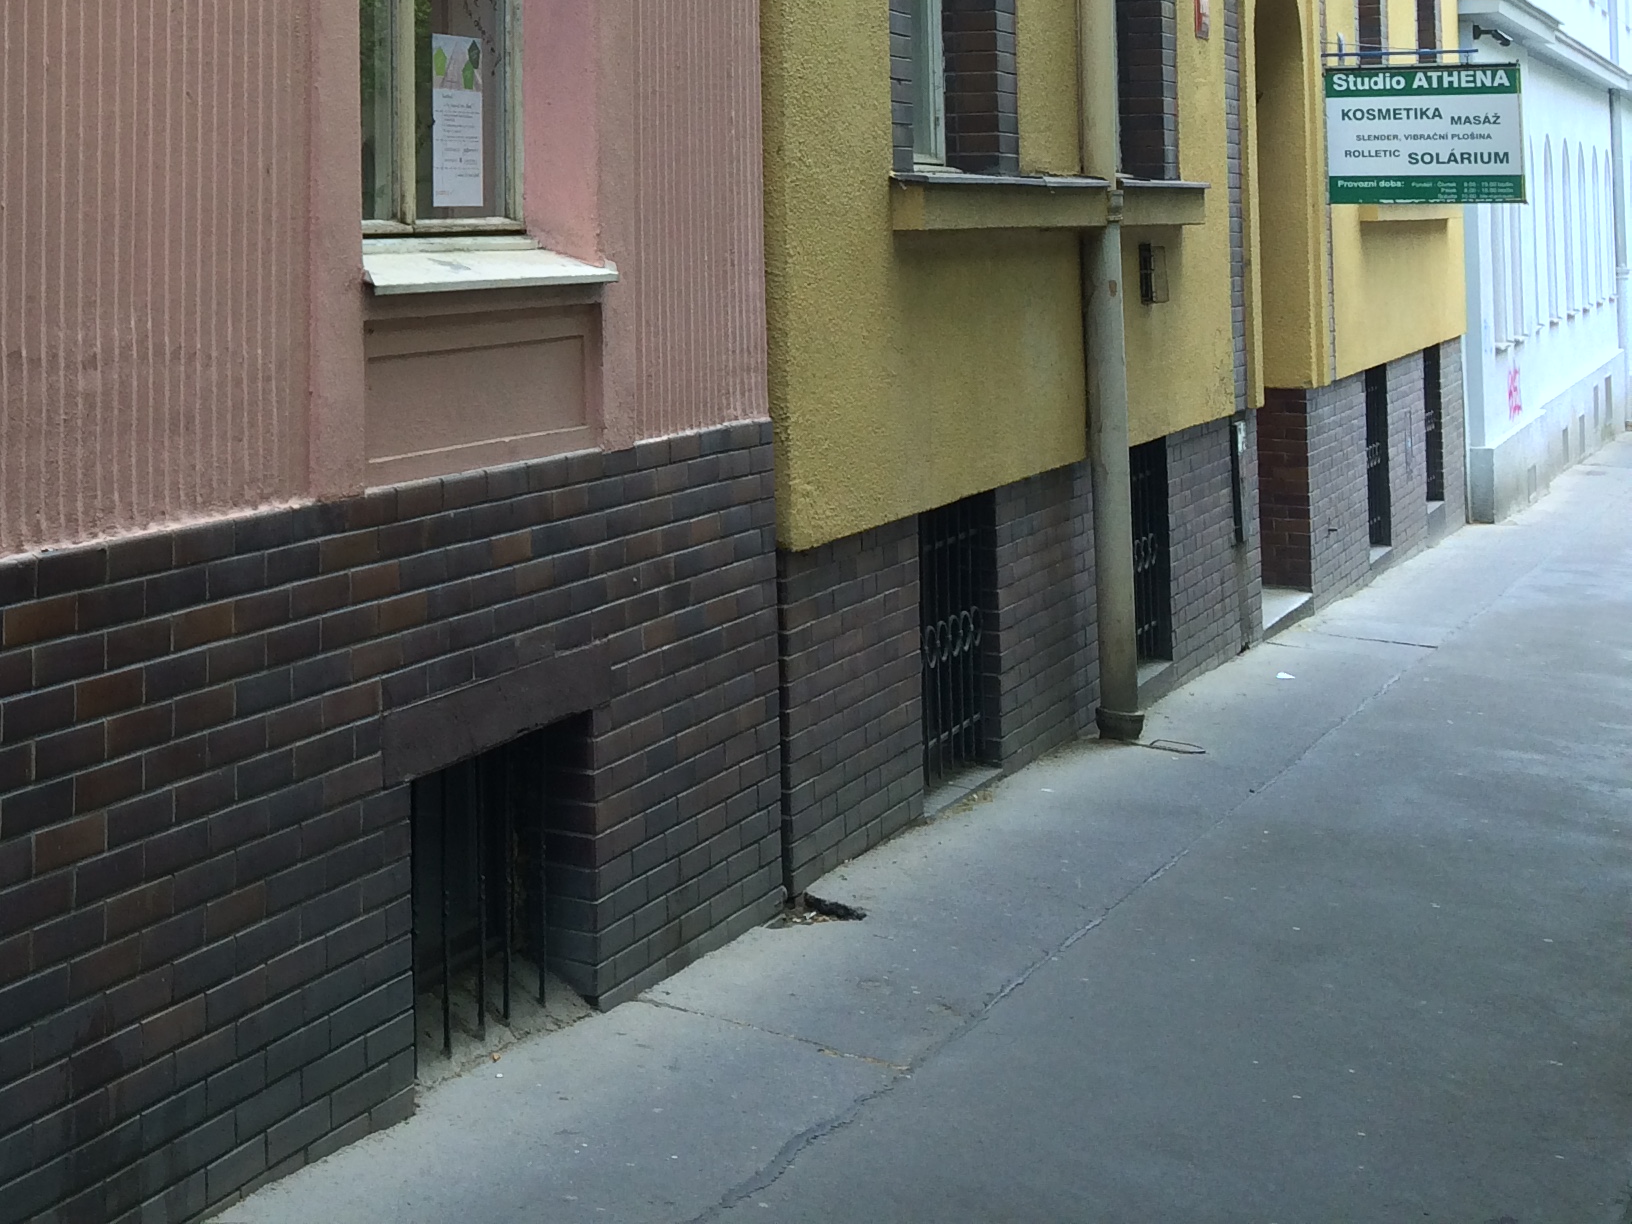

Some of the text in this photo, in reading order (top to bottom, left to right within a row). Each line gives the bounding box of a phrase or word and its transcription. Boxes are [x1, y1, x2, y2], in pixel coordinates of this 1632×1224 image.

[1332, 69, 1510, 91] Studio ATHENA
[1341, 107, 1501, 126] KOSMETIKA MASÁŽ
[1403, 132, 1449, 141] VIBRAČNÍ
[1451, 132, 1492, 141] PLOŠINA
[1344, 148, 1510, 165] ROLLETIC SOLÁRIUM
